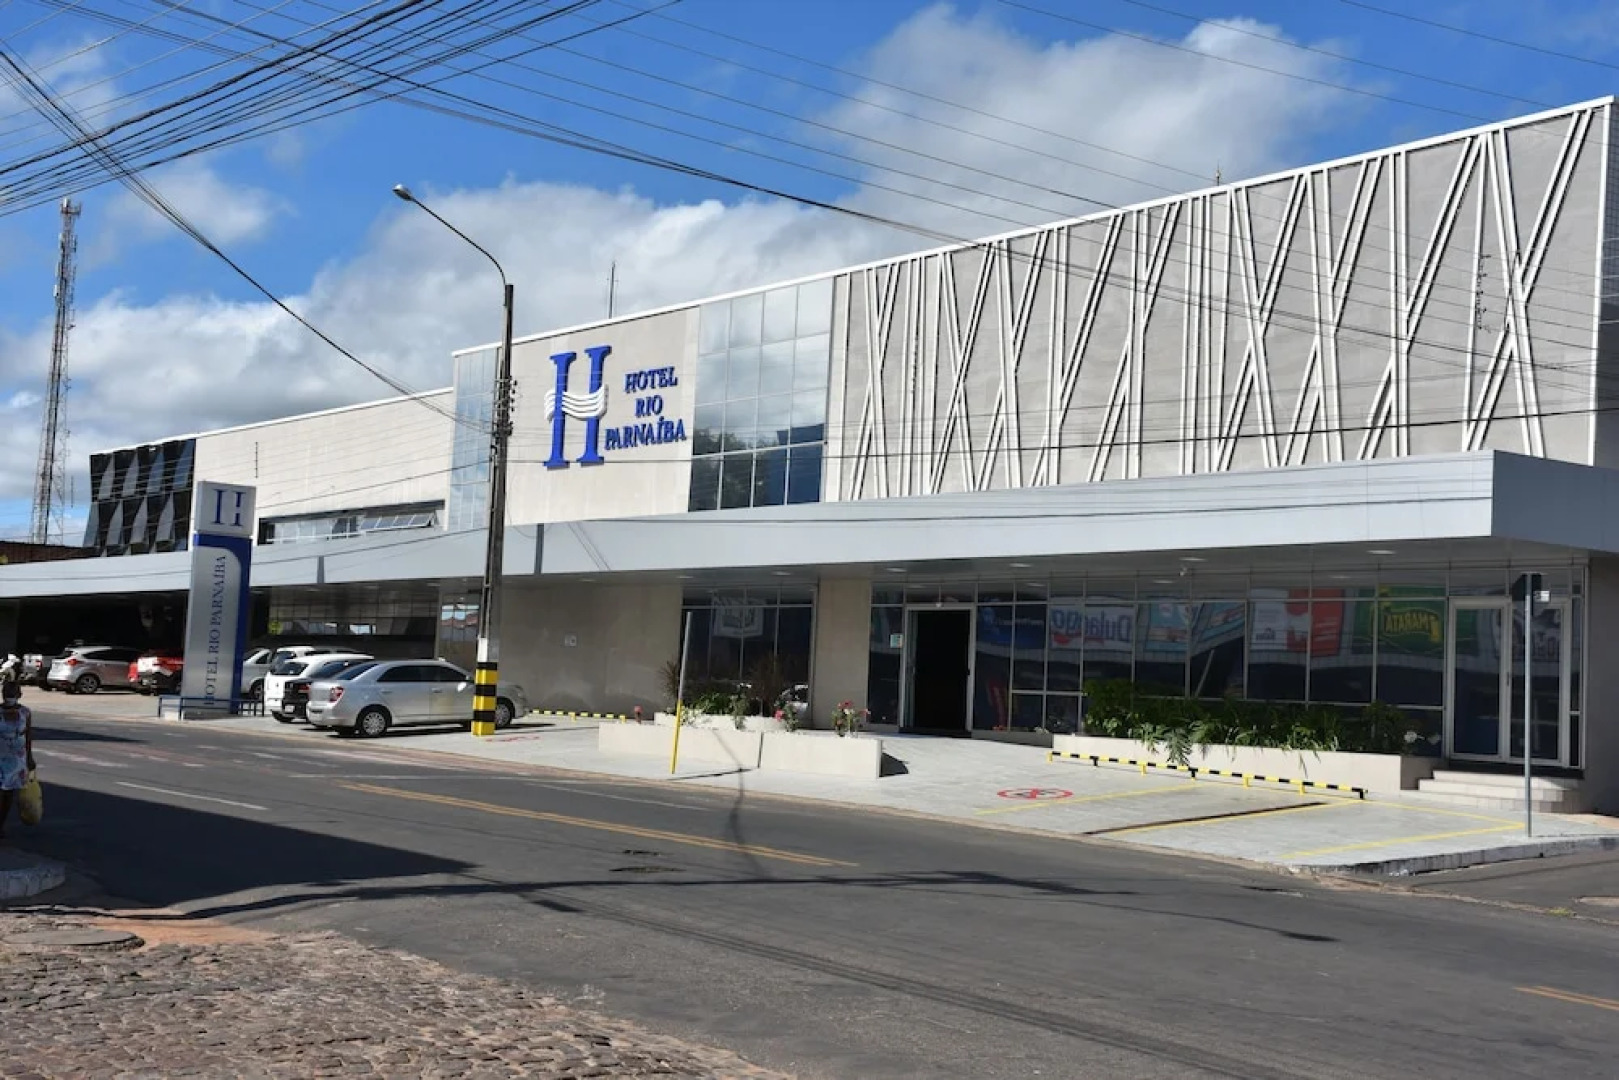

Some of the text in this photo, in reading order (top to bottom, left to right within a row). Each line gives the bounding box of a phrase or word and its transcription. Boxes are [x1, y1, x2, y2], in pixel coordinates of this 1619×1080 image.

[624, 366, 678, 393] HOTEL
[635, 395, 663, 418] RIO
[604, 416, 686, 450] PARNAÍBA
[208, 629, 220, 654] RIO
